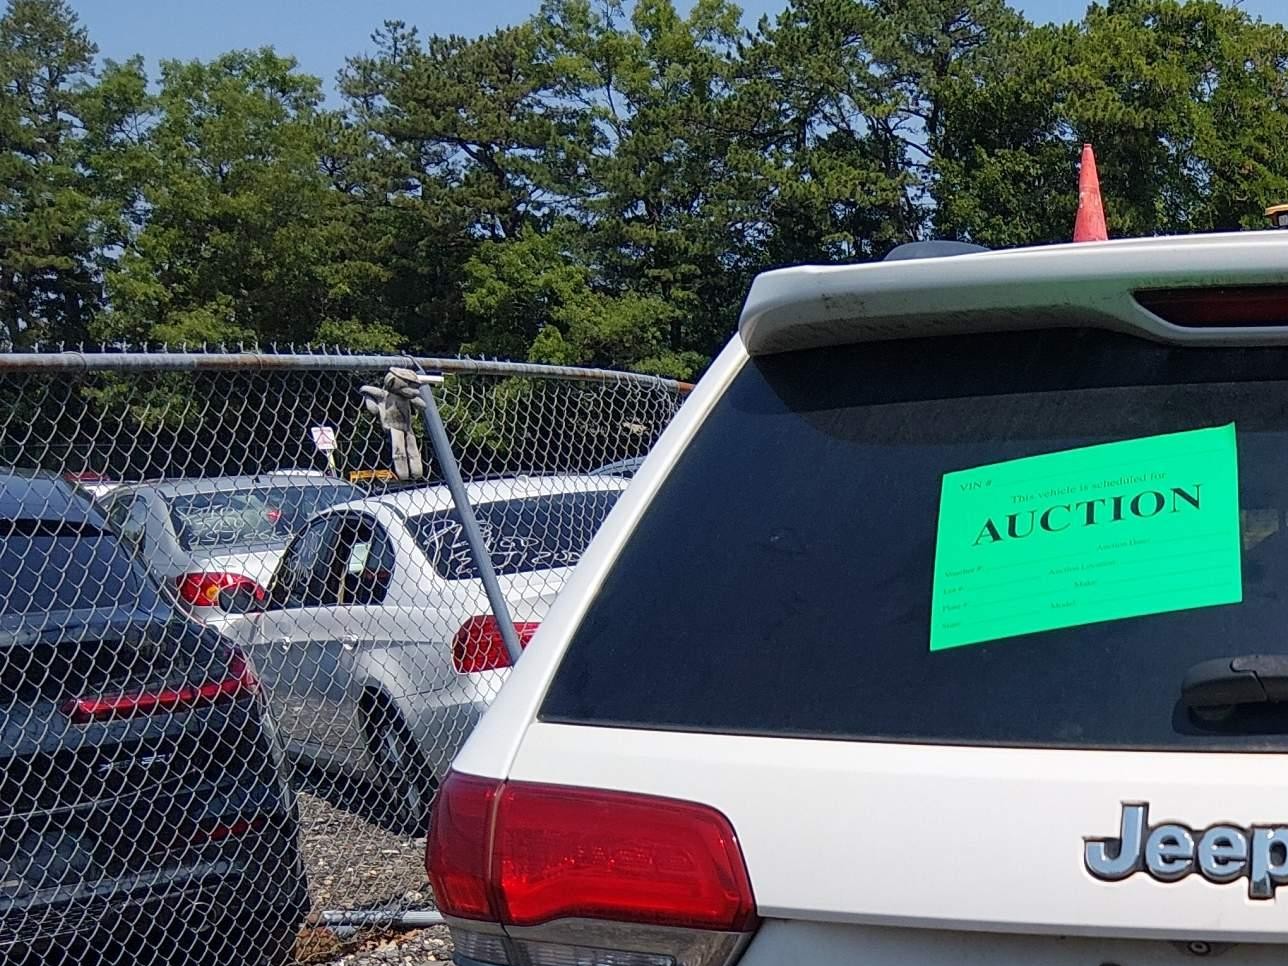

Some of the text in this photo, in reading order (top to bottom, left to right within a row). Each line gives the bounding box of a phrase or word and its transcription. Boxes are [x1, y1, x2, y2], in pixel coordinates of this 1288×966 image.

[959, 480, 983, 491] VIN
[1010, 471, 1168, 504] This vehicle is scheduled for
[971, 483, 1204, 546] AUCTION
